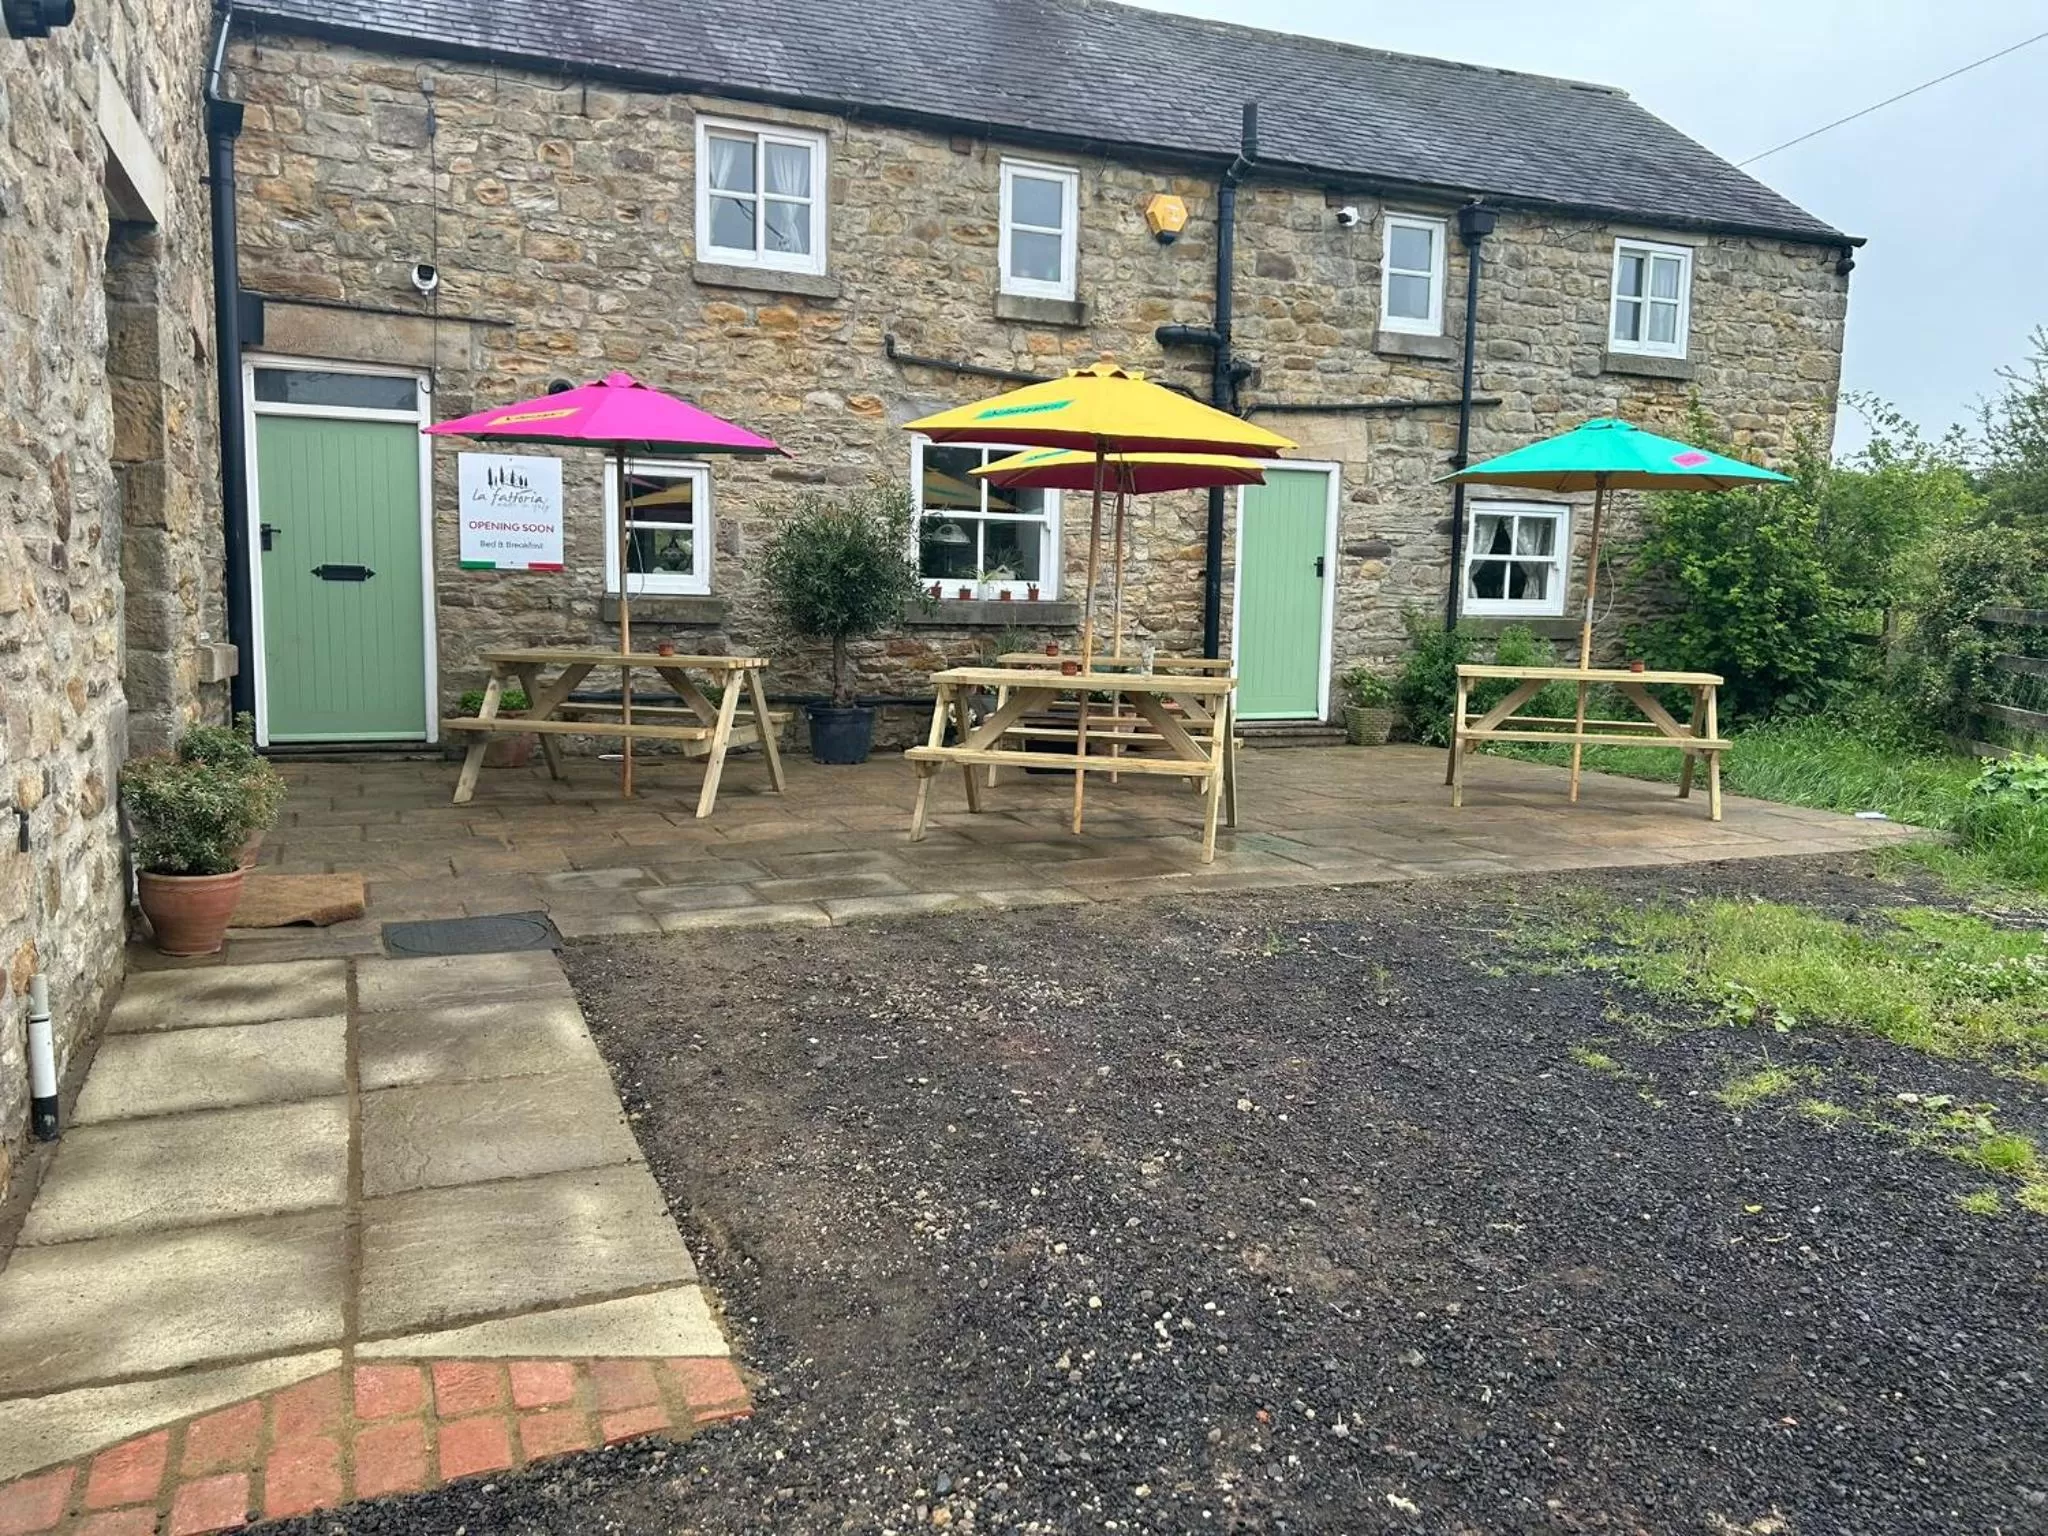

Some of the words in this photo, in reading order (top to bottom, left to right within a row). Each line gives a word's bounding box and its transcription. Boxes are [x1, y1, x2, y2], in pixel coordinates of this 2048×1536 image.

[472, 488, 488, 501] La
[490, 487, 544, 506] fattoria
[469, 521, 520, 532] OPENING
[522, 523, 555, 533] SOON
[480, 540, 496, 549] Bed
